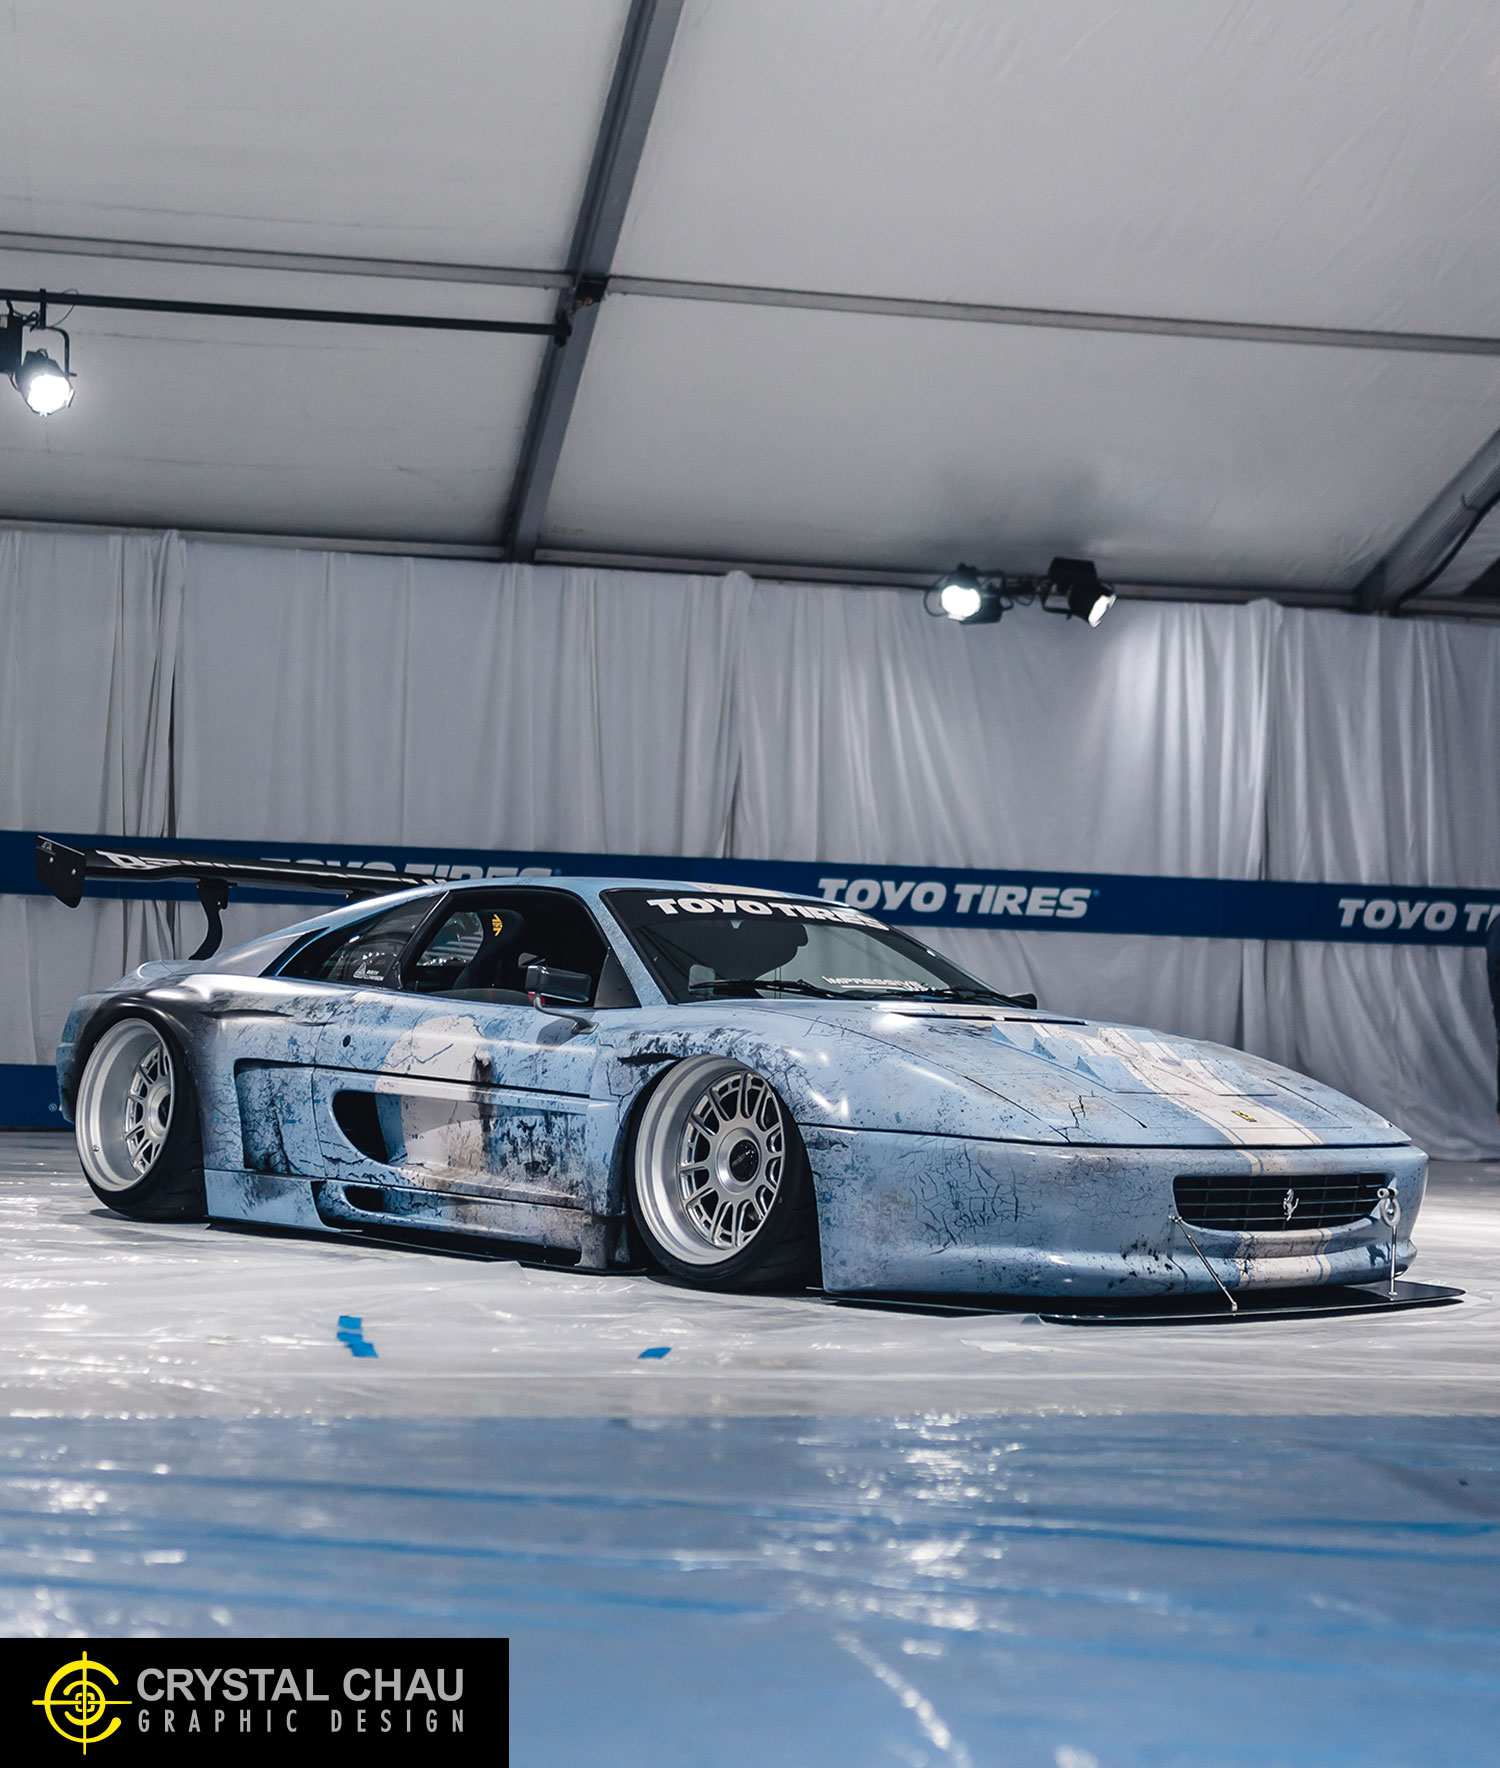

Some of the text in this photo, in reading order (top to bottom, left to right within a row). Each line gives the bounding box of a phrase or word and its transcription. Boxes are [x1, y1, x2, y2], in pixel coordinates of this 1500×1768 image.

[647, 898, 890, 932] TOYO TIRES
[818, 878, 1091, 918] TOYO TIRES
[1338, 898, 1457, 932] TOYO
